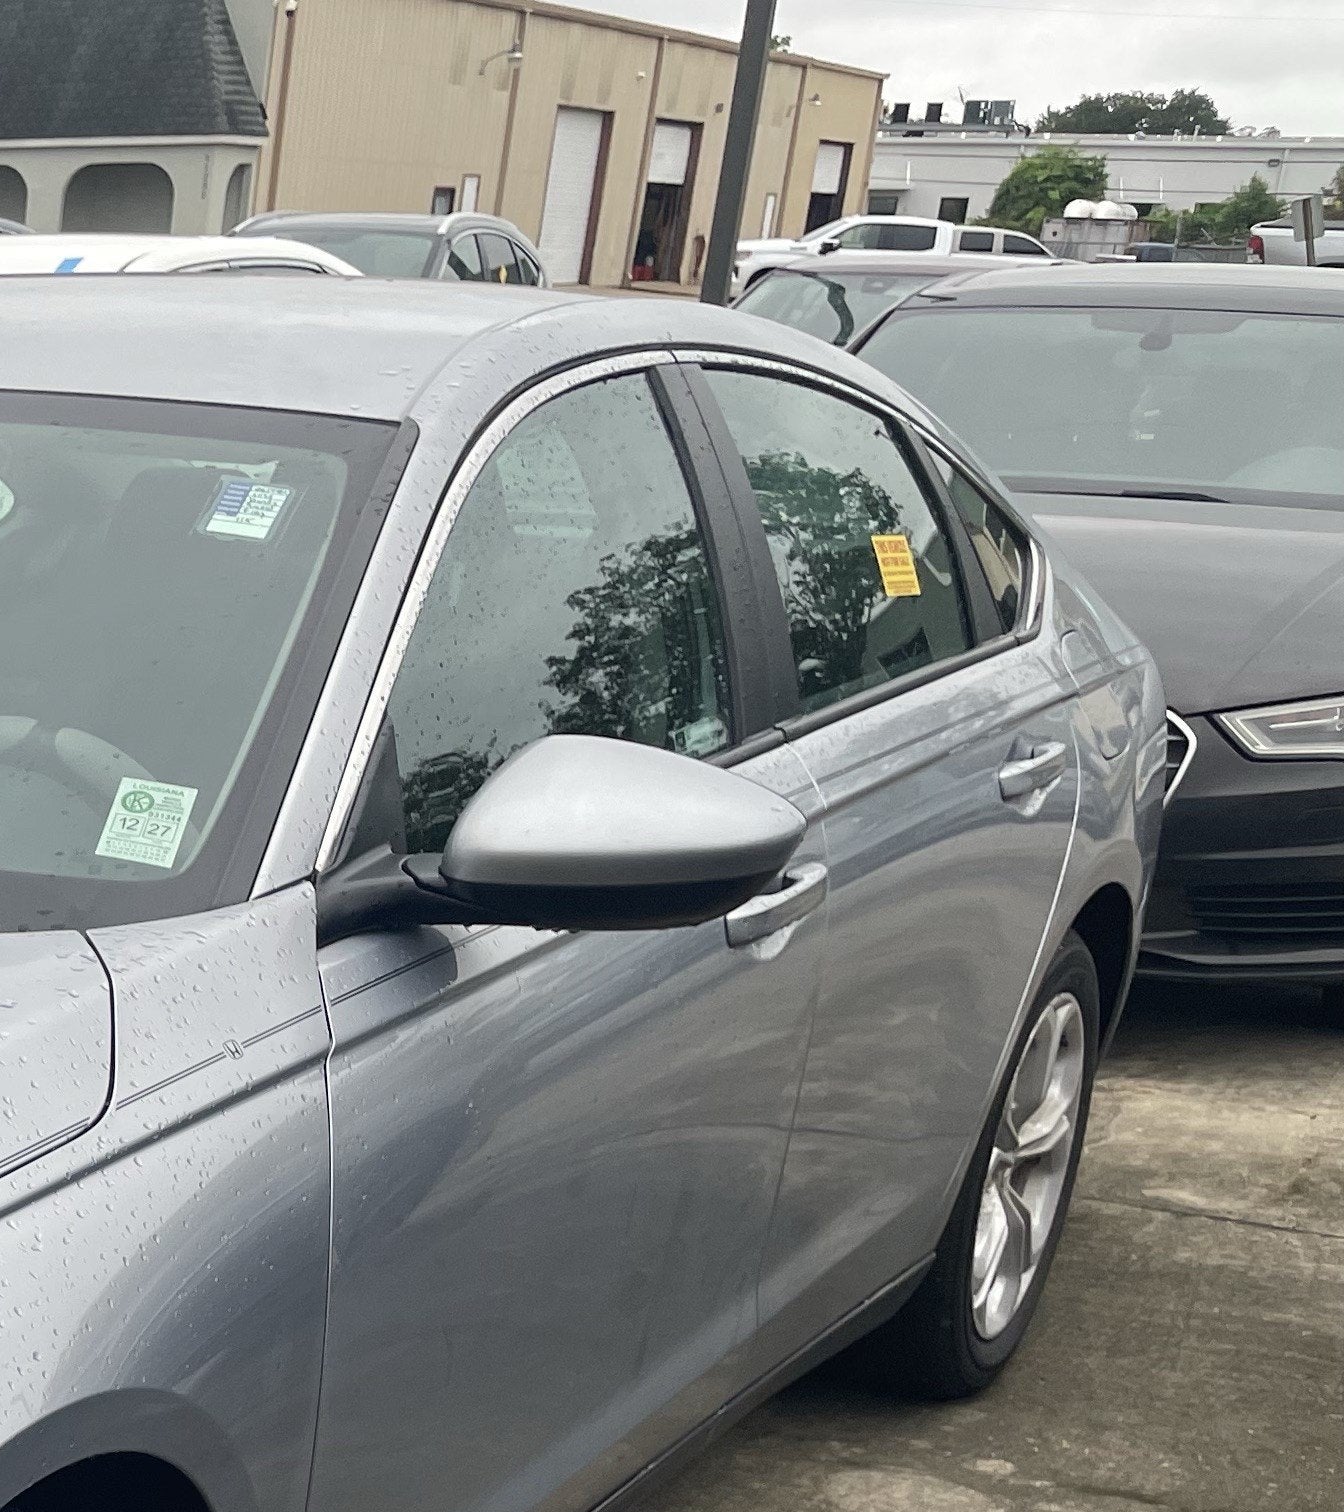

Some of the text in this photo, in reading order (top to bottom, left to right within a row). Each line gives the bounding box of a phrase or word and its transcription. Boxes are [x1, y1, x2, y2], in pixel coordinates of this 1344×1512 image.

[132, 782, 185, 797] LOUISIANA
[119, 817, 140, 832] 12
[147, 823, 172, 837] 27
